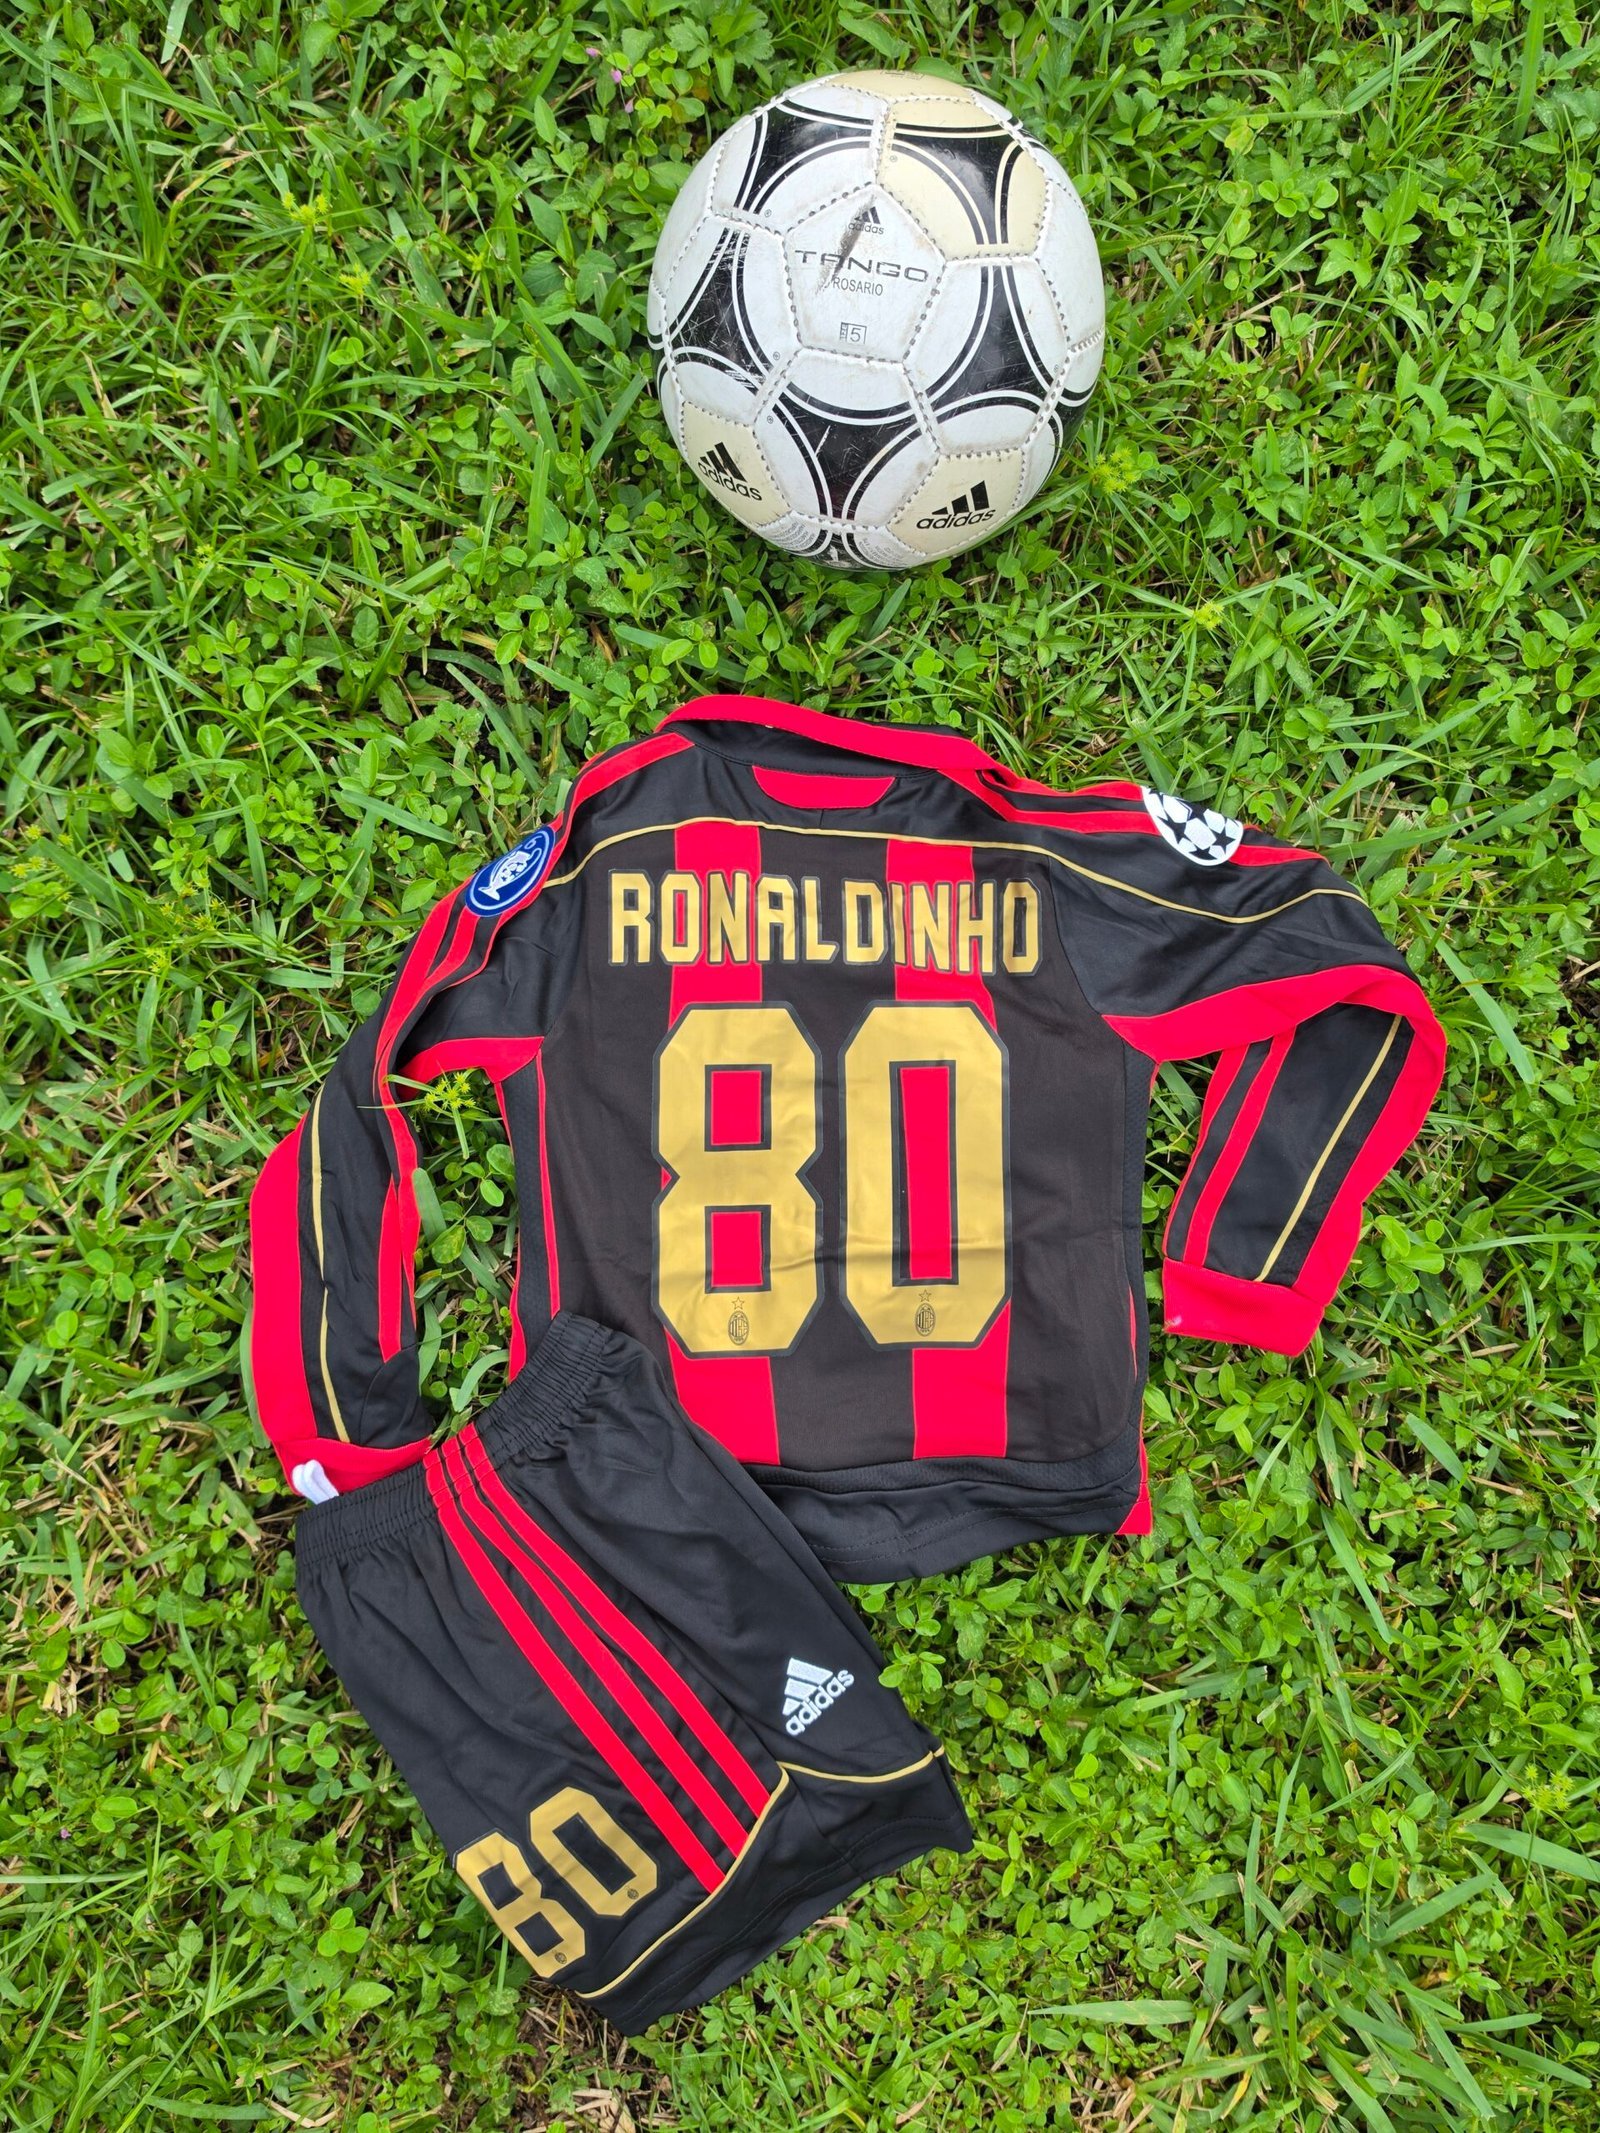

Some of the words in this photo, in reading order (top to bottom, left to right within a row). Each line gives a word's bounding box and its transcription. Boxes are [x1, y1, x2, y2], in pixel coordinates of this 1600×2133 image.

[848, 221, 884, 234] adidas
[795, 249, 929, 283] TANGO
[833, 276, 884, 296] ROSARIO
[850, 327, 861, 342] 5
[697, 461, 763, 501] adidas
[916, 510, 996, 530] adidas
[609, 870, 1041, 975] RONALDINHO
[653, 1002, 1011, 1357] 80
[785, 1669, 855, 1736] adidas
[454, 1785, 659, 1979] 80
